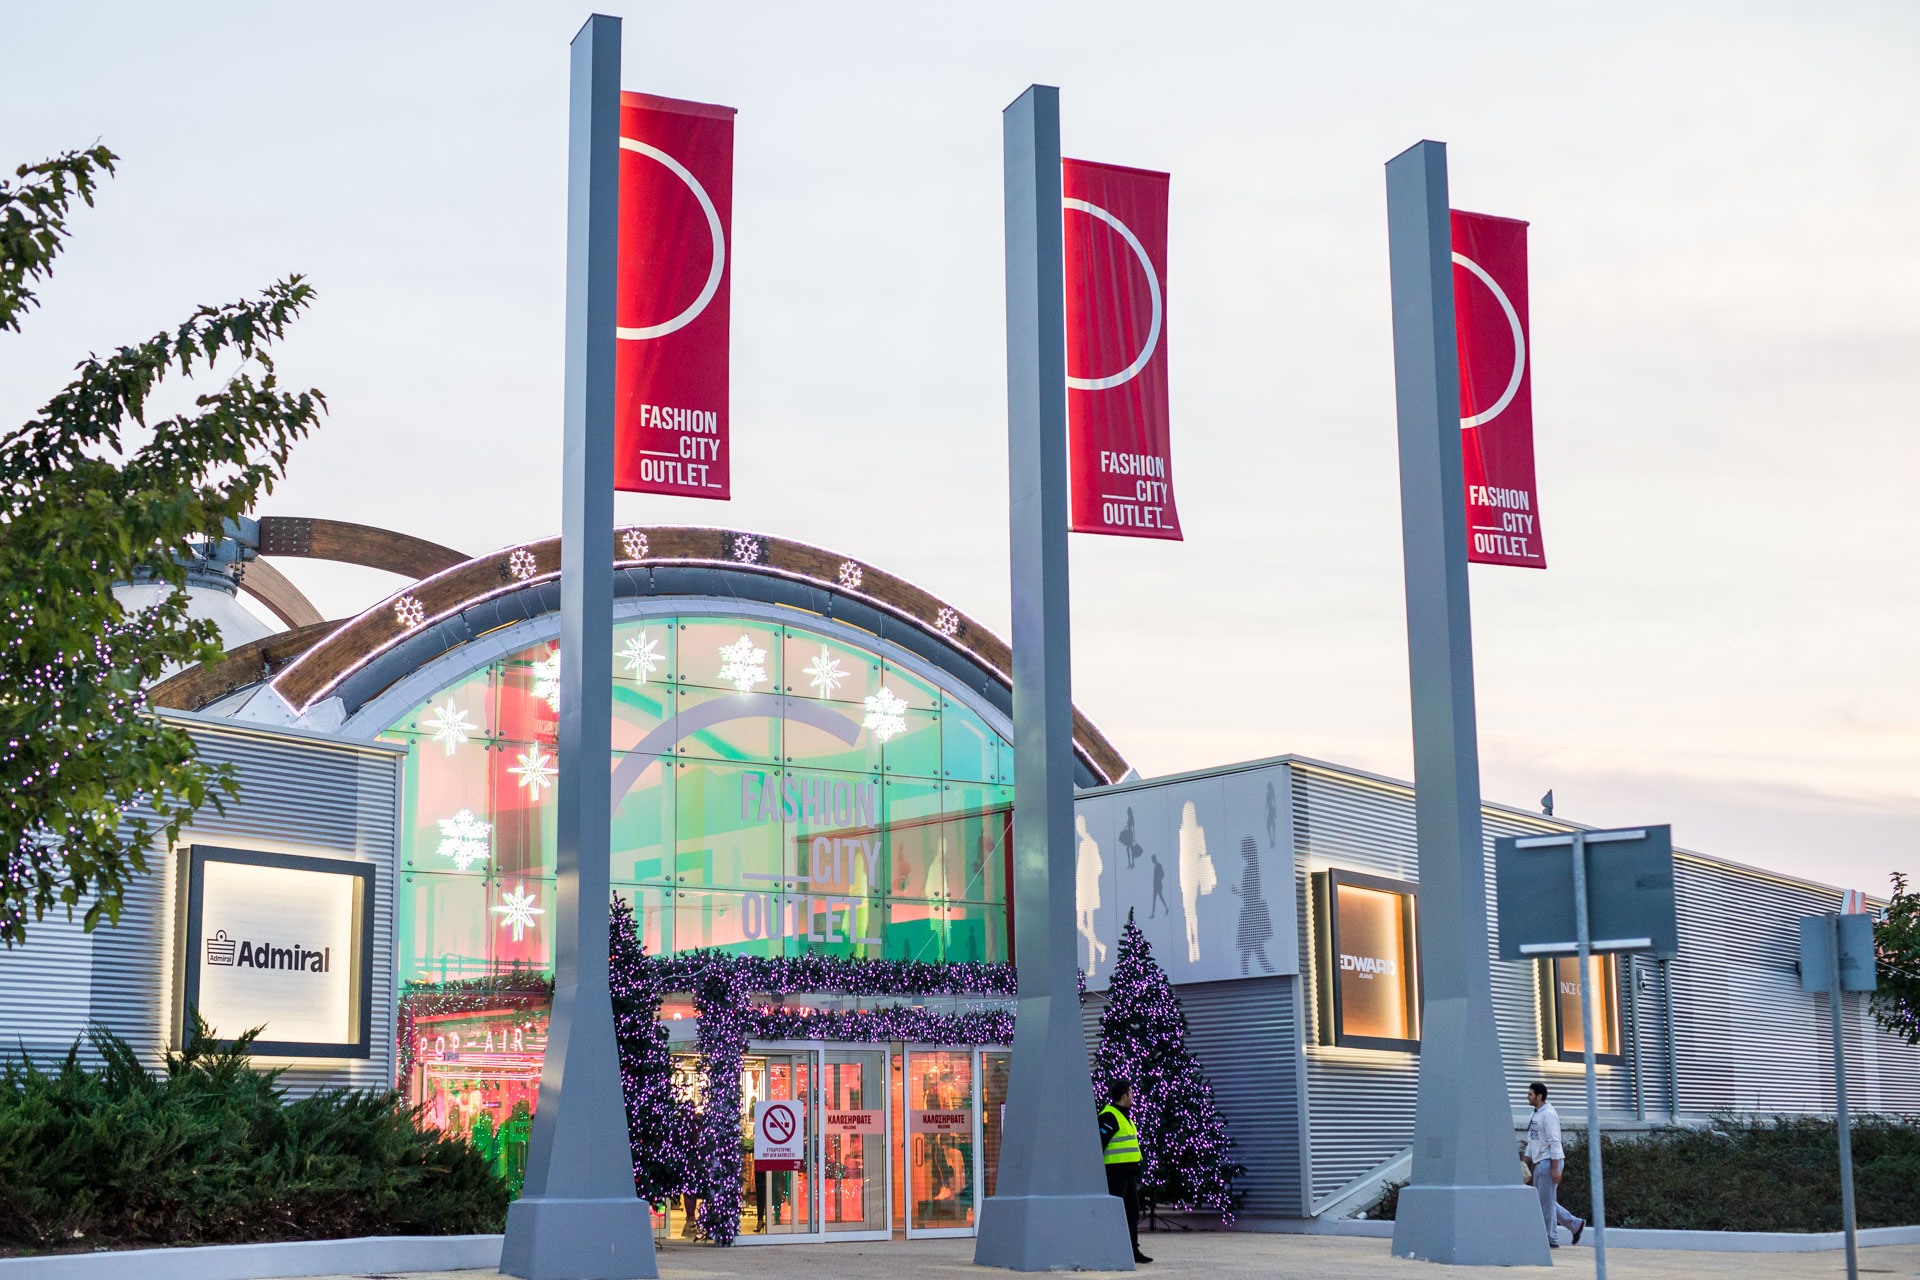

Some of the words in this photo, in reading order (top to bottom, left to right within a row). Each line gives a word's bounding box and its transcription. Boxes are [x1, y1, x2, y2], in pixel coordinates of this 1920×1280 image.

[641, 404, 717, 434] FASHION
[1101, 451, 1165, 478] FASHION
[1469, 485, 1530, 511] FASHION
[742, 773, 875, 829] FASHION
[210, 954, 232, 963] Admiral
[237, 941, 330, 973] Admiral
